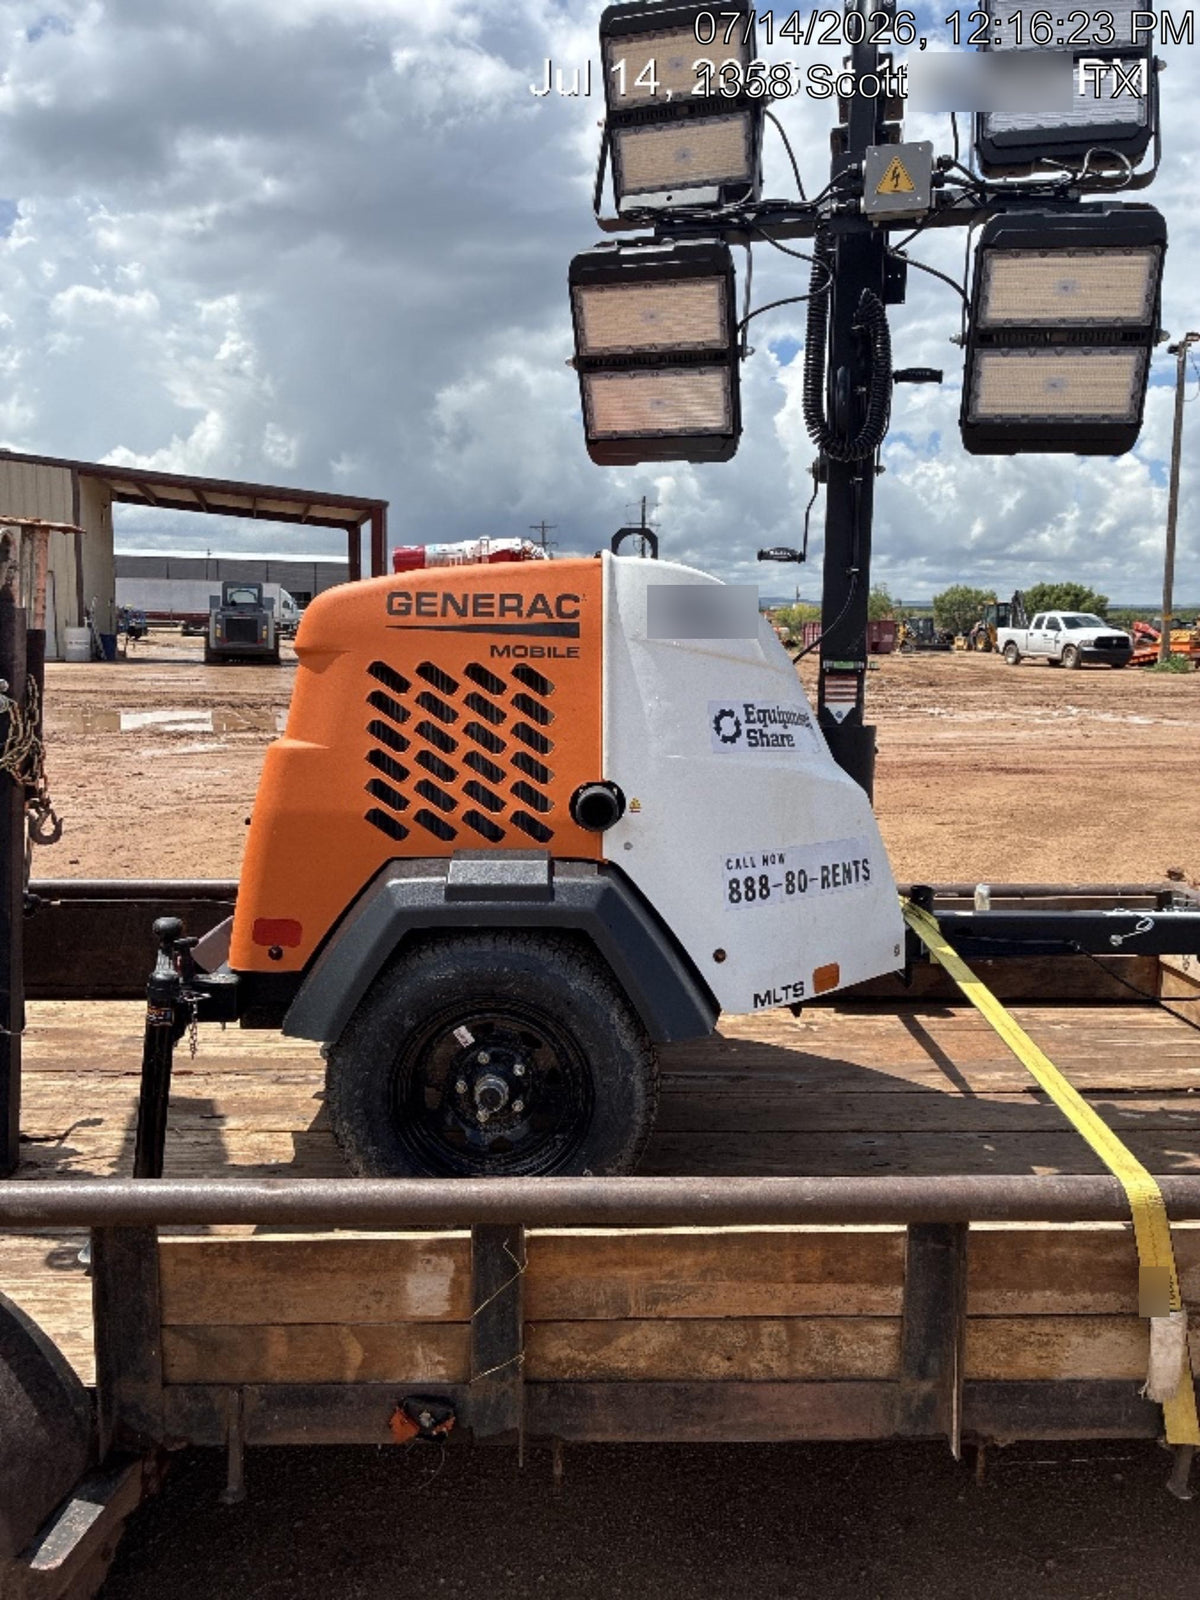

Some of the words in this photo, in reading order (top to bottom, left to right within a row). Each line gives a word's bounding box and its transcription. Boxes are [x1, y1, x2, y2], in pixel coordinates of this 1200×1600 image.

[387, 591, 581, 619] GENERAC
[490, 645, 580, 659] MOBILE
[746, 728, 795, 748] Share
[725, 856, 756, 870] CALL
[762, 853, 786, 867] NOW
[728, 858, 870, 903] 888-80-RENTS
[753, 981, 804, 1008] MLTS
